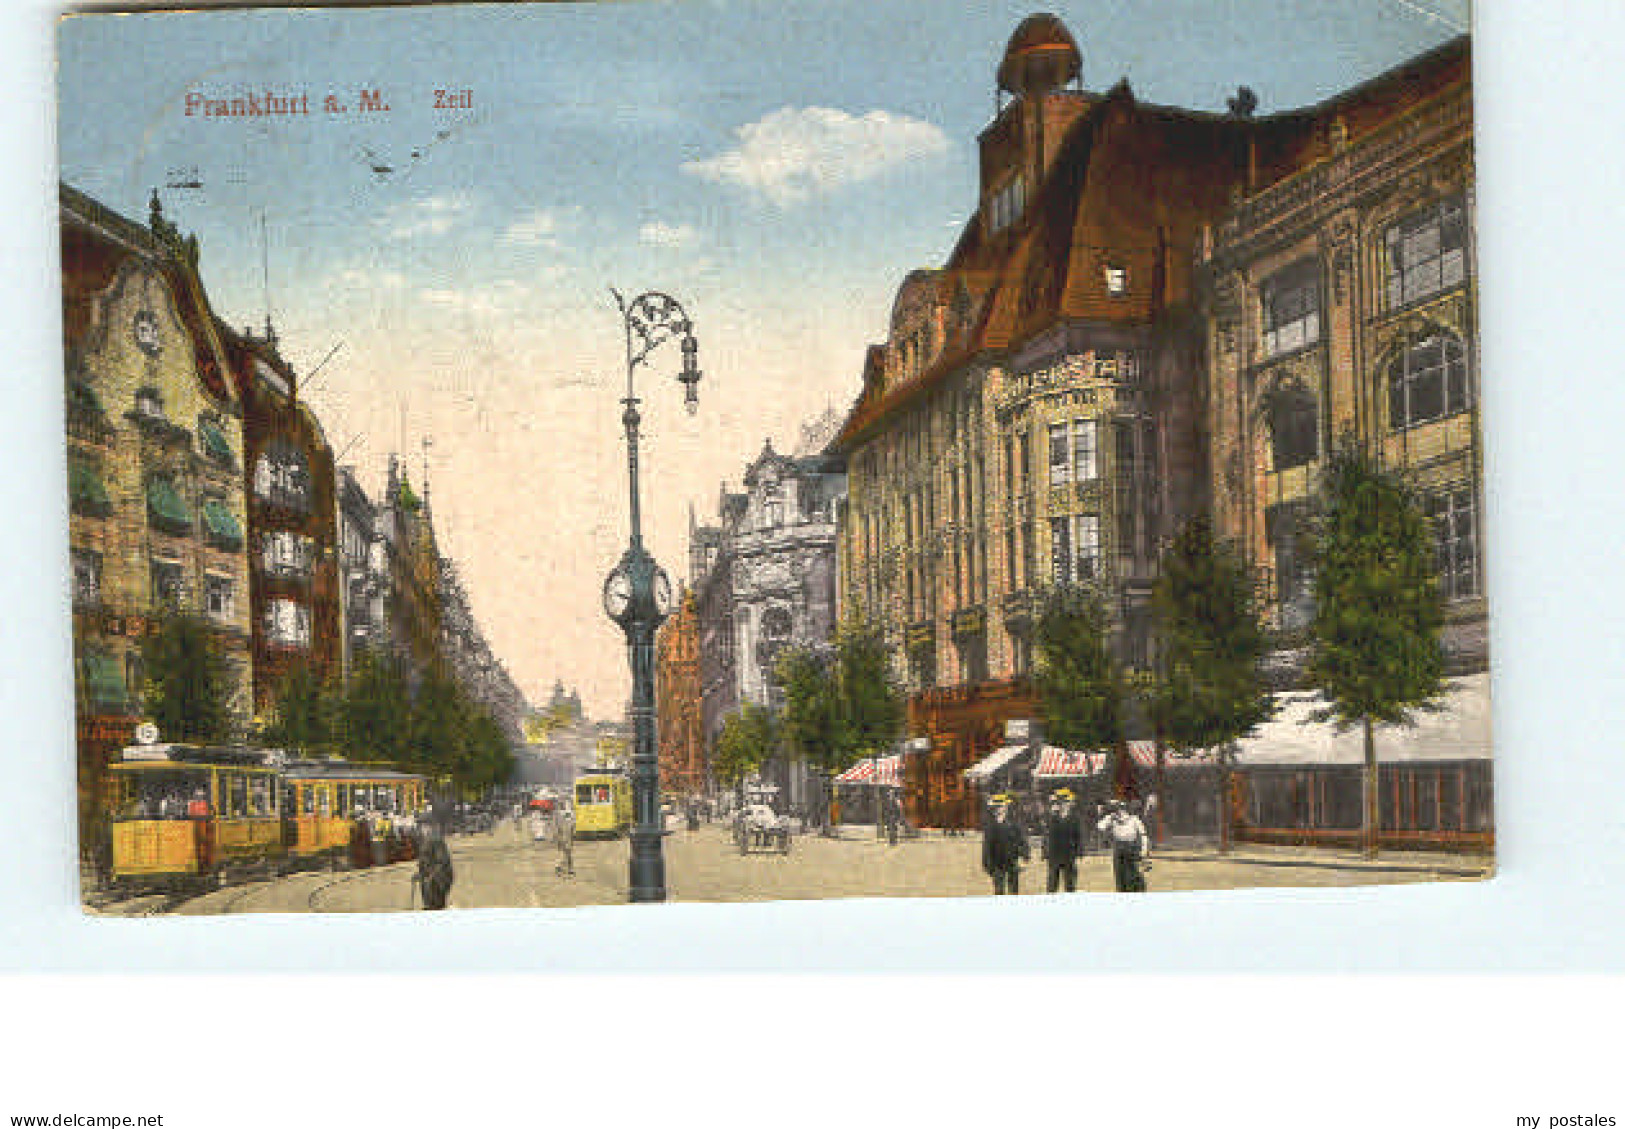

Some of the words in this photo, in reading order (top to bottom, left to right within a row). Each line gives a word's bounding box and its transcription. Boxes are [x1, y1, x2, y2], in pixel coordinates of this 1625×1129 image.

[184, 91, 309, 117] Frankfurt
[324, 94, 348, 114] a.
[359, 89, 391, 114] M.
